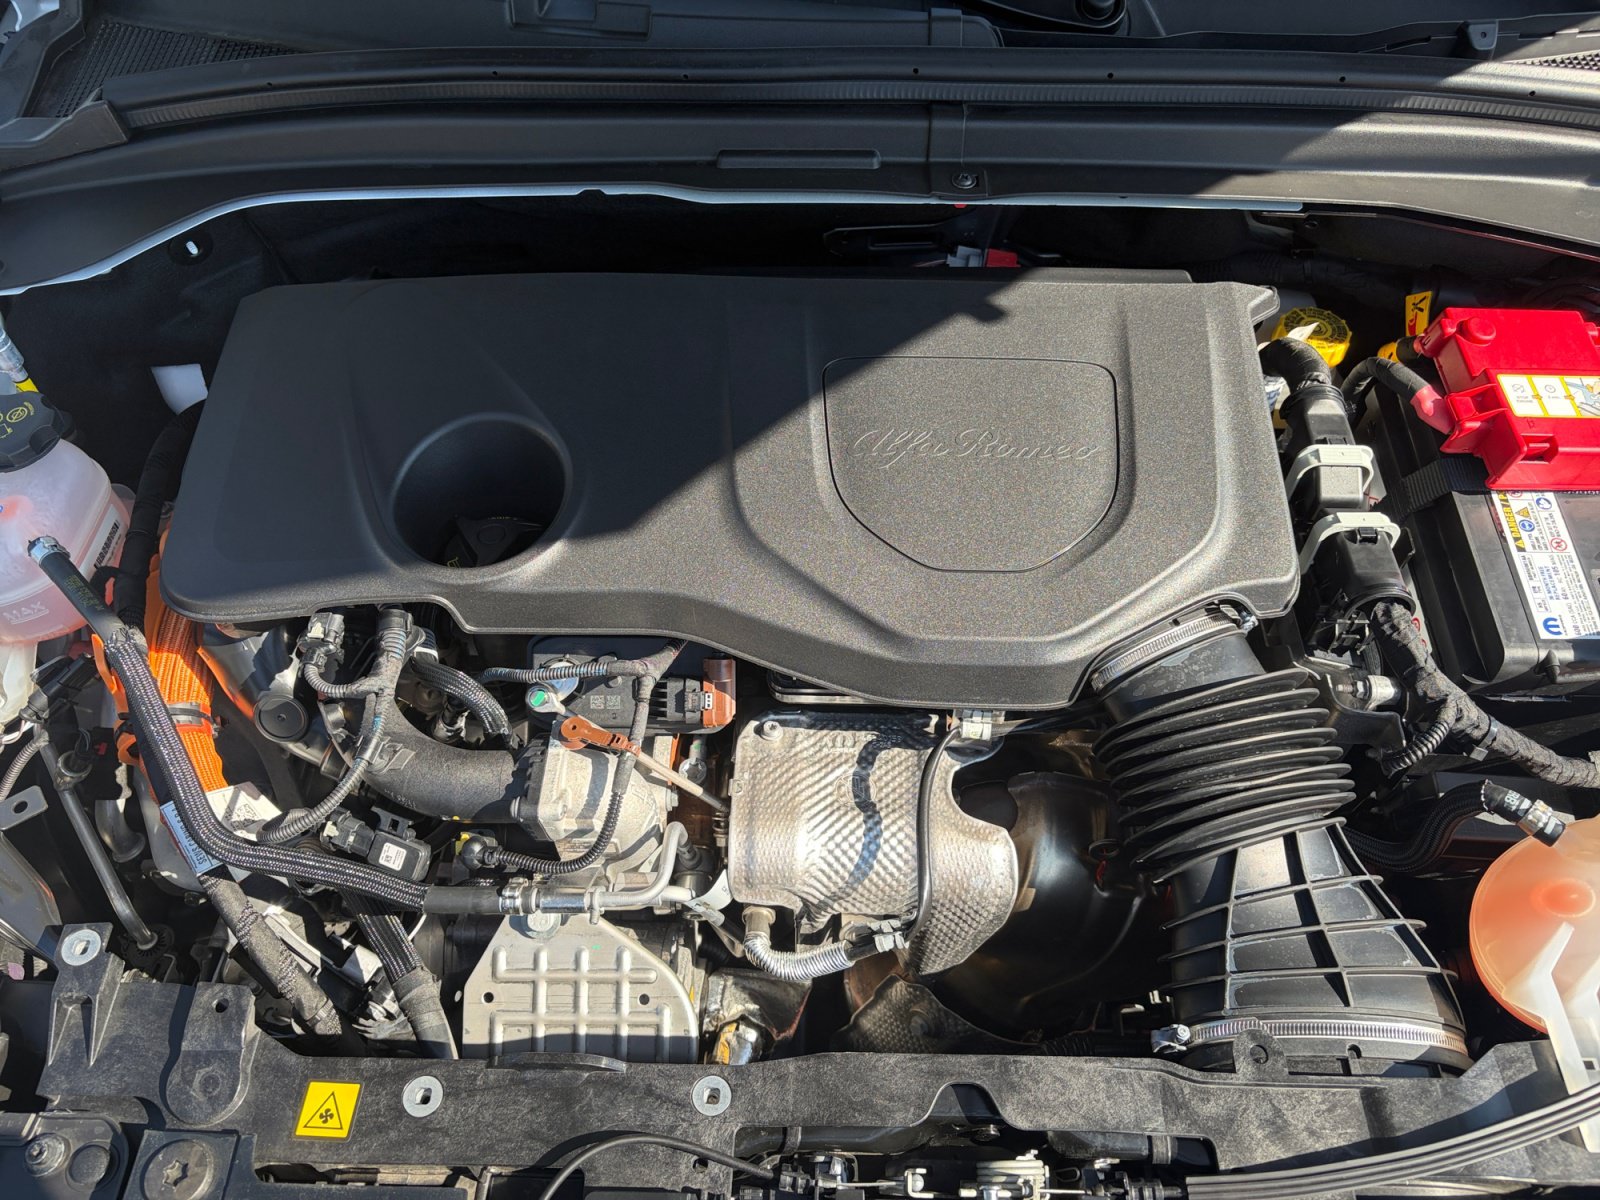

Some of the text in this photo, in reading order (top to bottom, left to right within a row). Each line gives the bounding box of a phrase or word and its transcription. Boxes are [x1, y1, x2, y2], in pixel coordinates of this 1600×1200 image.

[955, 427, 1100, 461] Romeo
[1503, 507, 1521, 538] DANGER
[3, 601, 46, 622] MAX
[191, 846, 207, 865] SEWS
